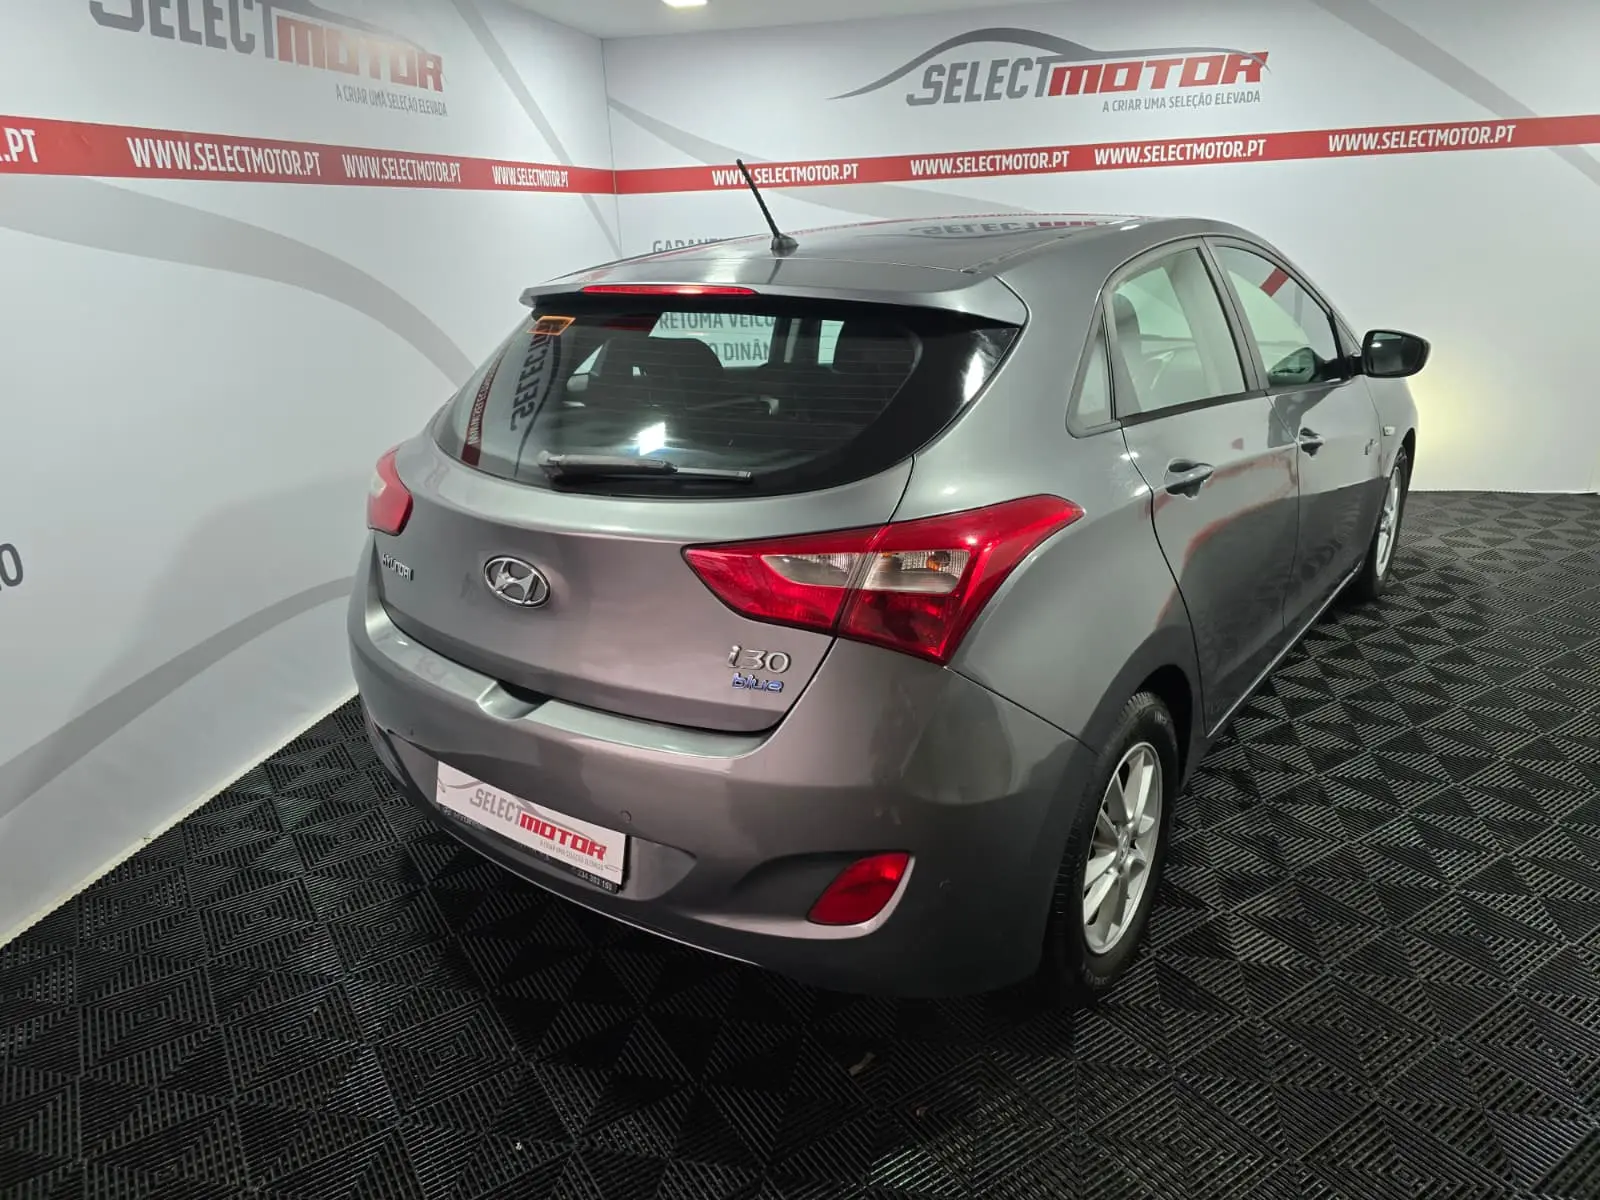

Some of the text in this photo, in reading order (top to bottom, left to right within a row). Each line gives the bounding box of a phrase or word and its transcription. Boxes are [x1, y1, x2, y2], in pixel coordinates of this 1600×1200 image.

[343, 85, 368, 105] CRIAR
[369, 89, 387, 108] UMA
[419, 98, 448, 116] ELEVADA
[1102, 90, 1261, 113] A CRIAR UMA SELEÇÃO ELEVADA
[0, 127, 39, 163] .PT
[1094, 138, 1266, 166] WWW.SELECTMOTOR.PT
[1328, 124, 1517, 152] WWW.SELECTMOTOR.PT
[127, 136, 320, 177] WWW.SELECTMOTOR.PT
[342, 153, 461, 184] WWW.SELECTMOTOR.PT
[911, 150, 1070, 176] WWW.SELECTMOTOR.PT
[492, 165, 569, 189] WWW.SELECTMOTOR.PT
[711, 163, 859, 186] WWWSELECTMOTOR.PT
[383, 553, 414, 581] HYUNDAI
[727, 645, 792, 674] i30
[732, 672, 785, 693] blue
